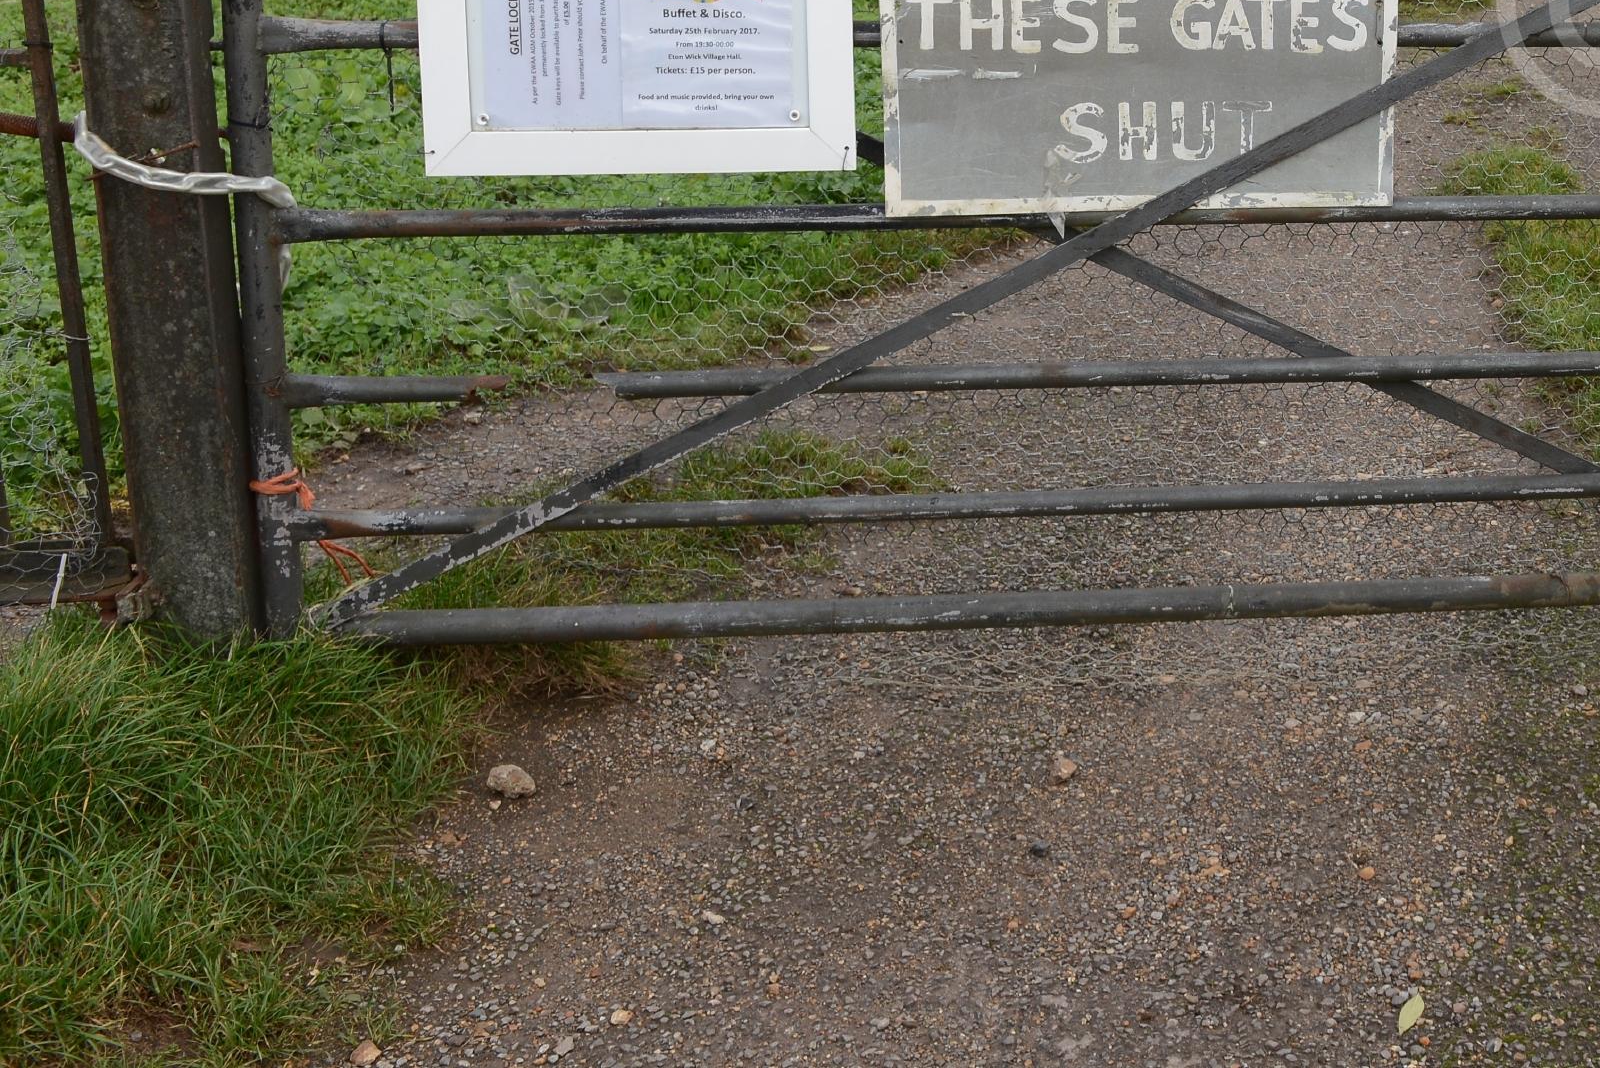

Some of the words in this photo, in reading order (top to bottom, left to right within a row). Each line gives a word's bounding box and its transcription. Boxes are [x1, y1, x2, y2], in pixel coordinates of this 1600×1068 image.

[663, 9, 696, 18] Buffet
[700, 9, 709, 18] &
[713, 9, 745, 19] Disco.
[509, 26, 520, 55] GATE
[601, 56, 607, 64] On
[1054, 101, 1272, 164] SHUT
